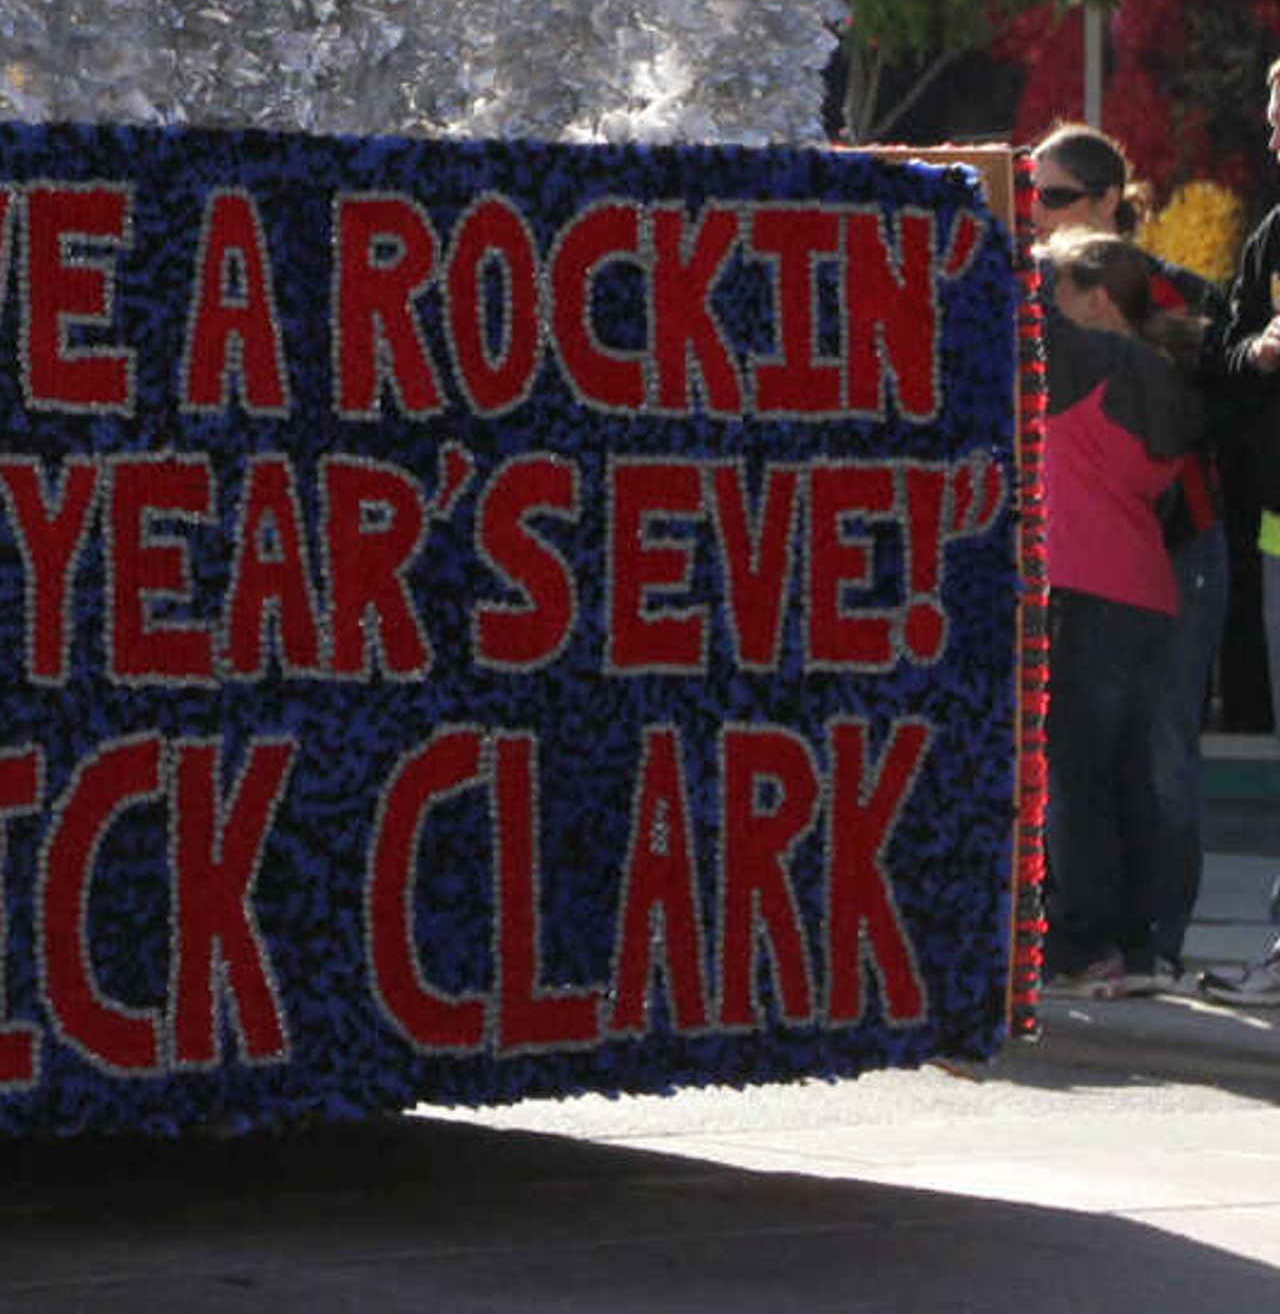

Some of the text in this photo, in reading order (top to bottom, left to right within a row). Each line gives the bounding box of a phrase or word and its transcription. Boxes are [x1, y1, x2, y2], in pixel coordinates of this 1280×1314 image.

[180, 184, 292, 418] A
[329, 189, 984, 421] ROCKIN'
[602, 448, 1006, 676] EVE!"
[365, 715, 937, 1058] CLARK
